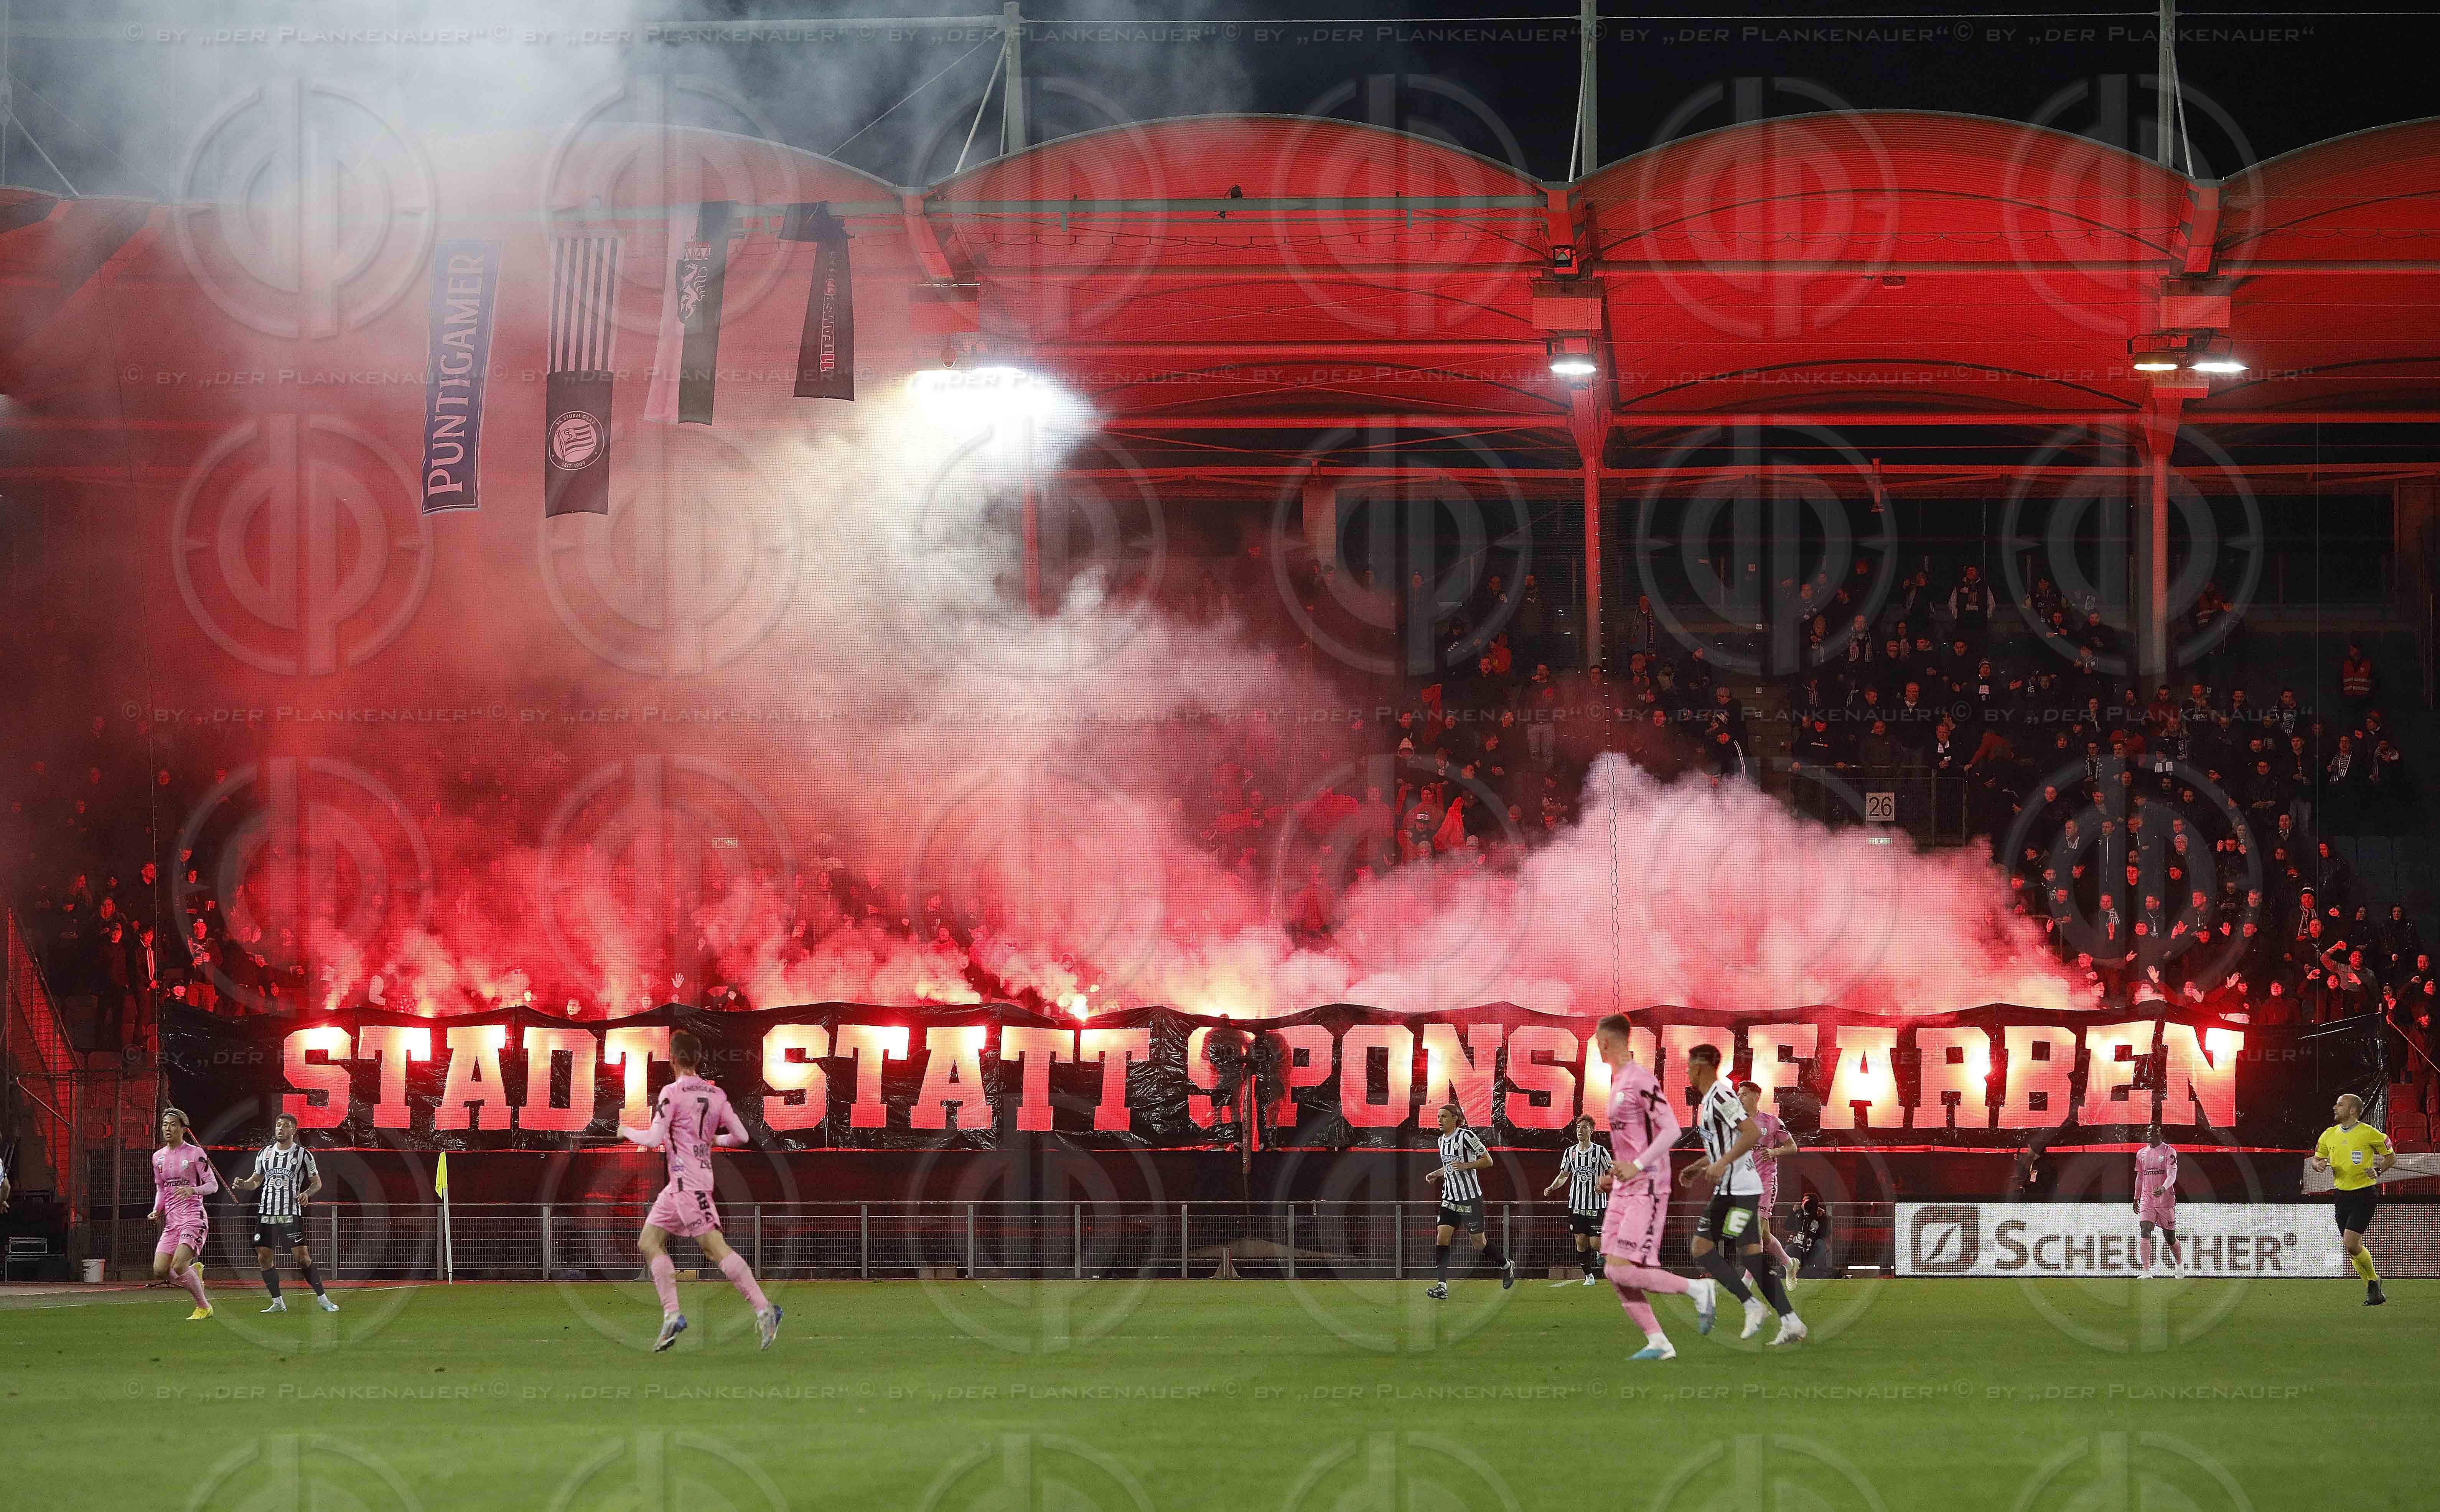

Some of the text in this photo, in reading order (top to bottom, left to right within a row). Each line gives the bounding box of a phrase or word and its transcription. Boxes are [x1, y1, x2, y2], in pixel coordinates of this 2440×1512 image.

[427, 253, 485, 497] PUNTIGAMER
[582, 414, 596, 425] GRAZ
[1868, 796, 1892, 817] 26
[283, 1025, 670, 1132] STADT
[762, 1024, 1150, 1131] STATT
[697, 1097, 710, 1139] 7
[1441, 1200, 1472, 1213] GRAZ
[1573, 1208, 1598, 1217] GRAZ
[261, 1215, 294, 1224] GRAZ
